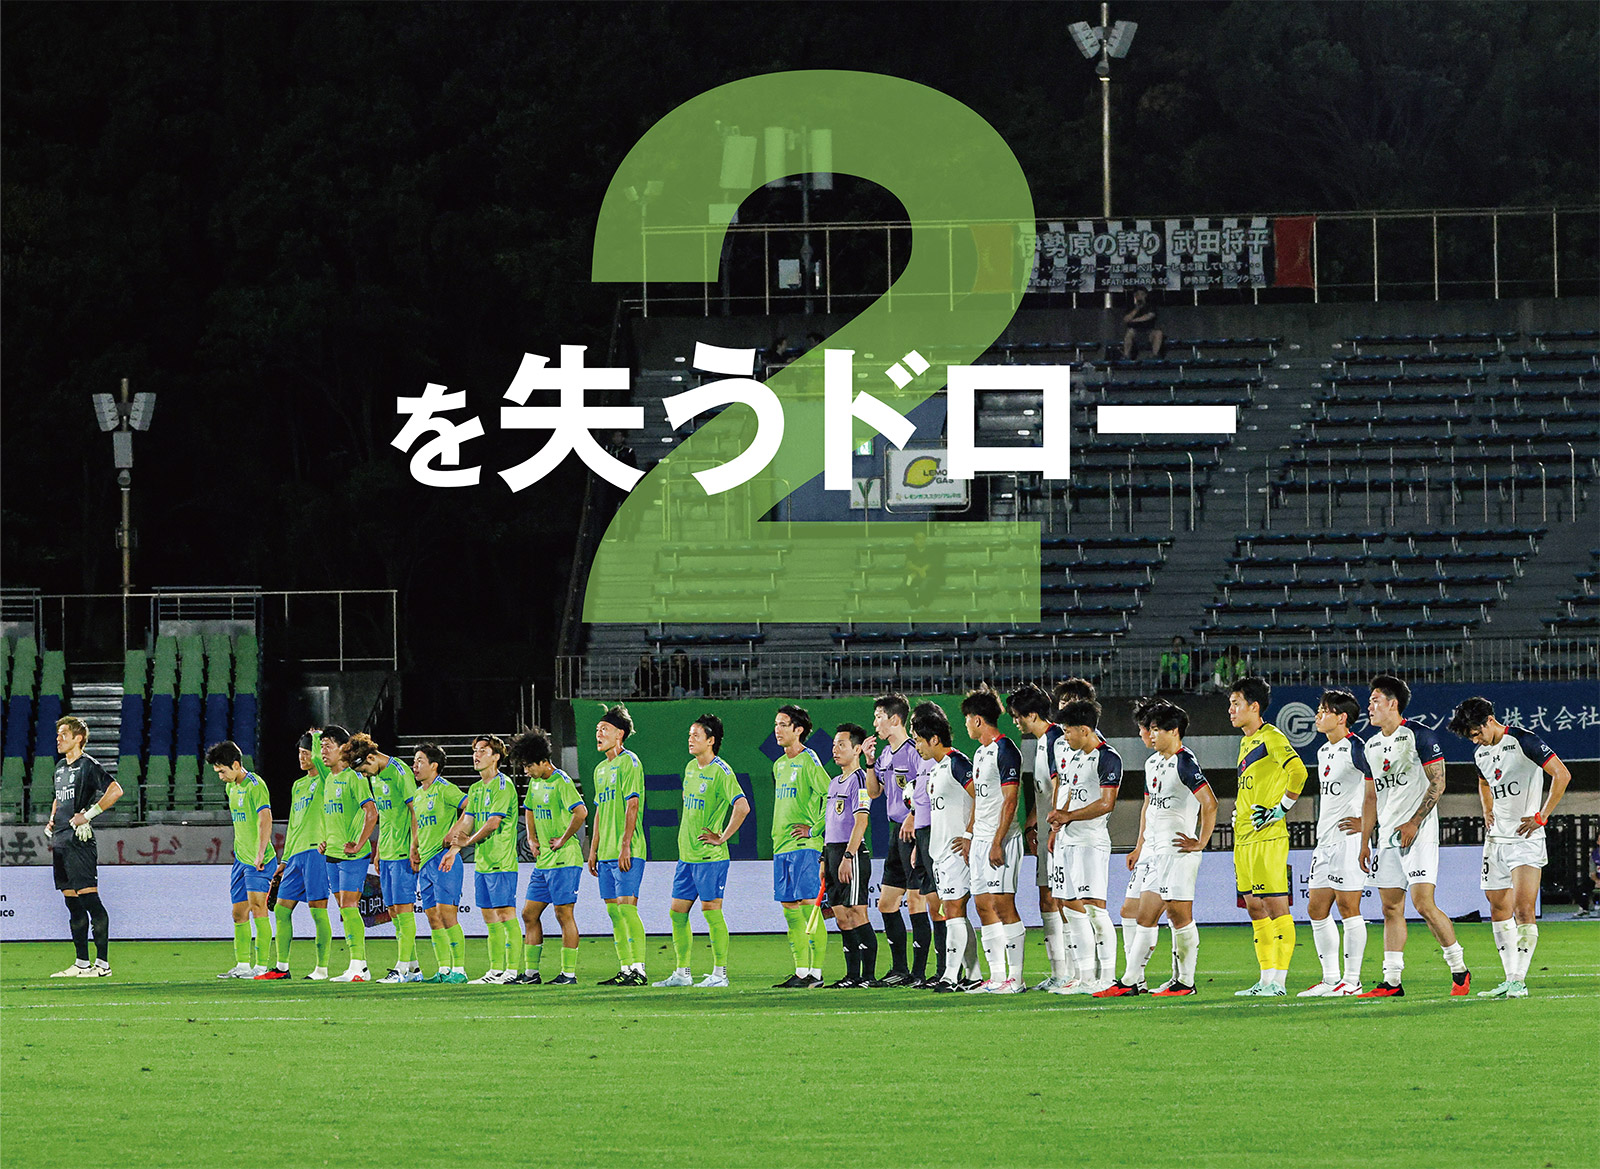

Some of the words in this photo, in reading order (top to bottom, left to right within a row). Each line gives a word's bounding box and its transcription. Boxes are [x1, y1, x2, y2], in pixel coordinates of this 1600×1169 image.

[1172, 228, 1269, 255] 武田将平
[923, 469, 947, 477] LEMO
[1375, 772, 1408, 792] BHC
[1491, 781, 1521, 800] HC
[1053, 865, 1065, 884] 35
